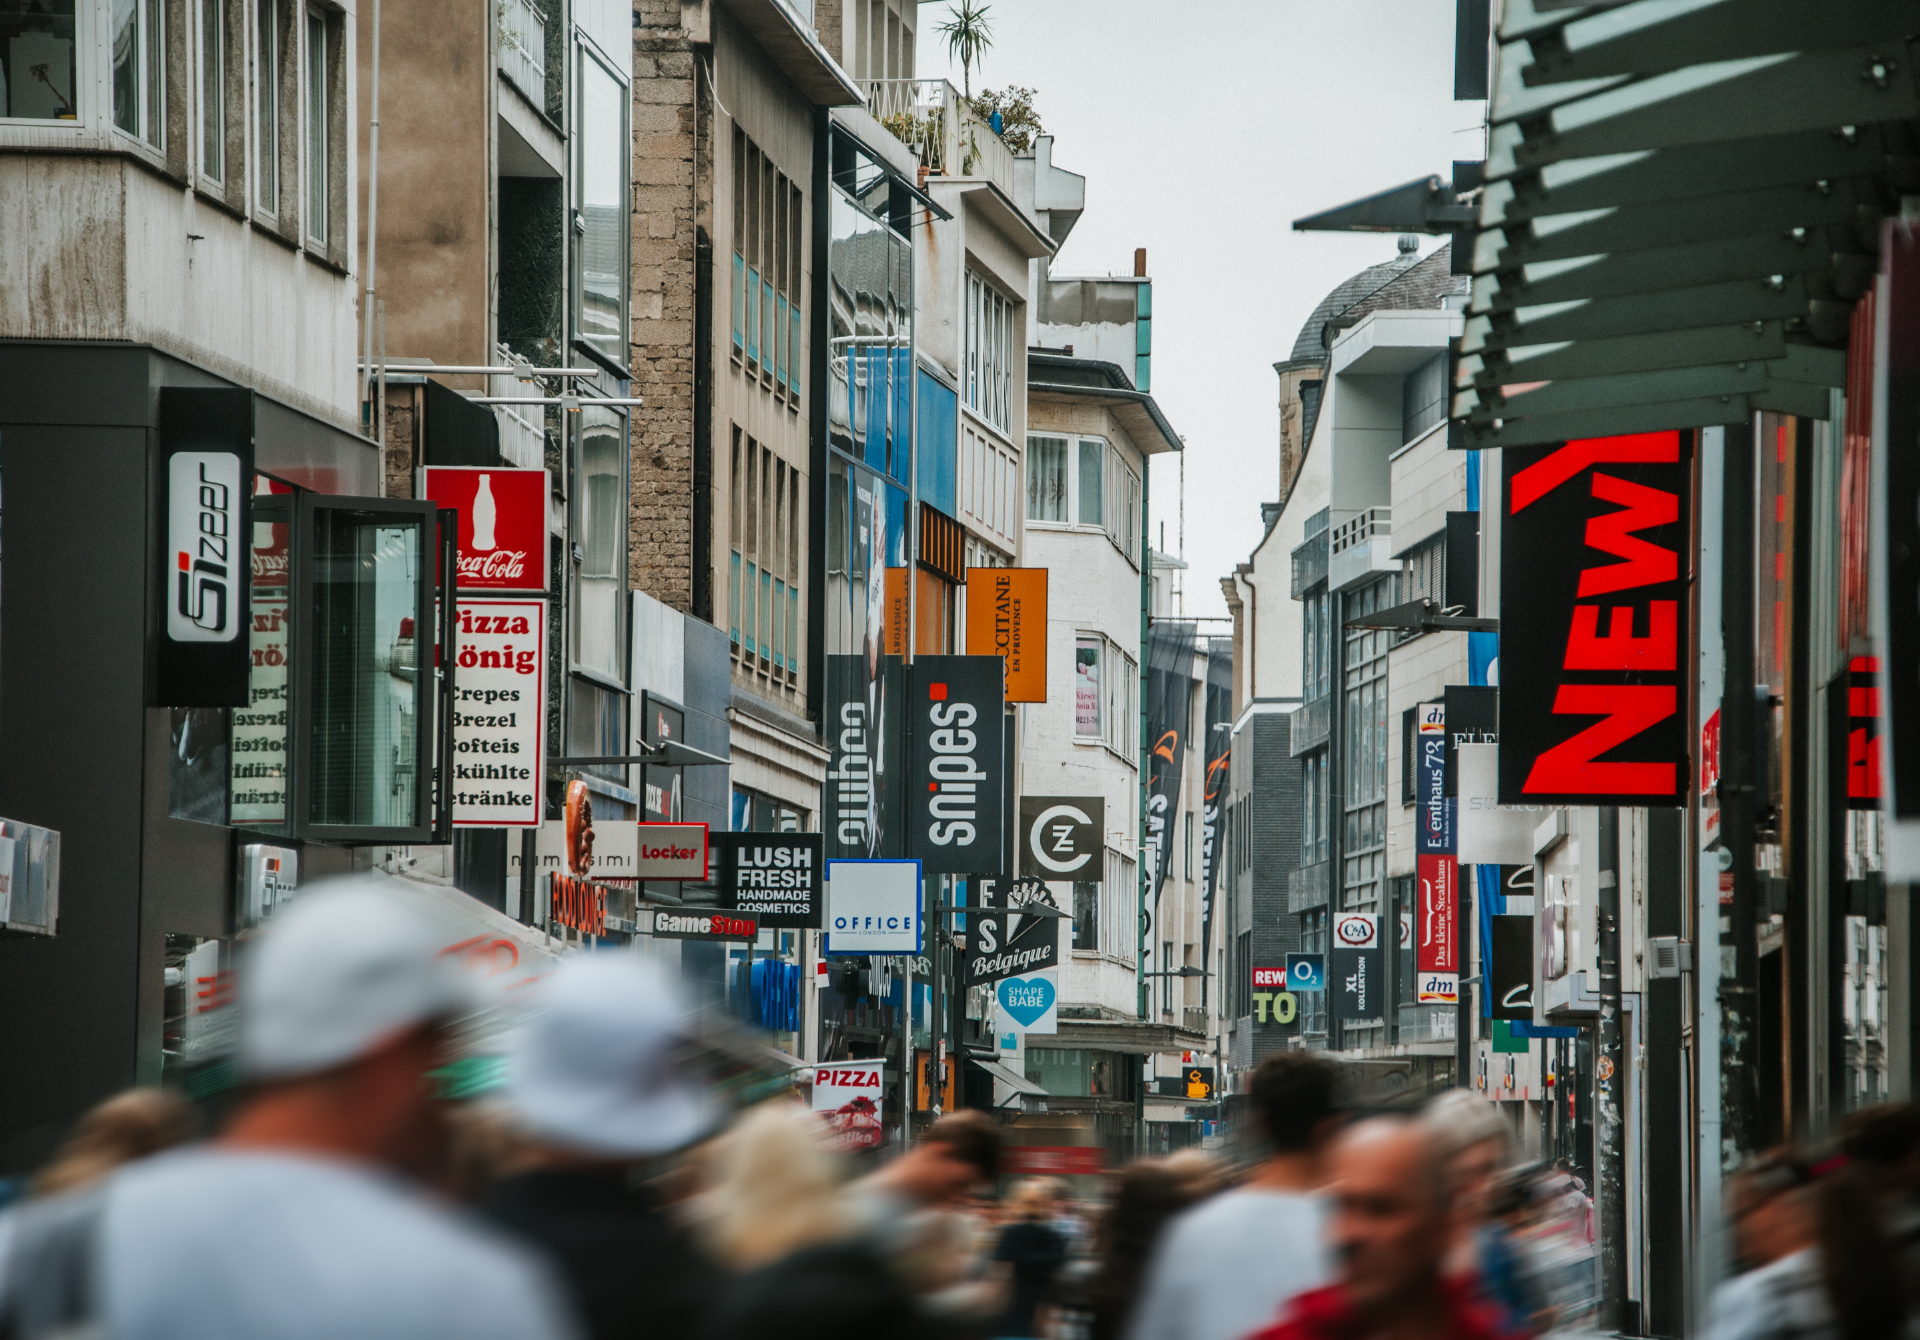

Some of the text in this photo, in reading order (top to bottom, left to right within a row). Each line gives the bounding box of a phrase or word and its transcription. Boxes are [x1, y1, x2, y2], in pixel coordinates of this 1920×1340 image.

[457, 550, 527, 578] oca-Cola
[1013, 598, 1021, 672] EN PROVENCE
[1522, 472, 1678, 795] NEW
[929, 702, 986, 846] snipes
[642, 844, 697, 860] Locker
[737, 847, 812, 868] LUSH
[737, 869, 812, 888] FRESH
[737, 889, 811, 901] HANDMADE
[736, 902, 811, 914] COSMETICS
[1435, 859, 1446, 967] Das kleine Steakhaus
[655, 912, 756, 937] GameStop
[835, 917, 911, 929] OFFICE
[1344, 923, 1368, 937] C&A
[972, 945, 1051, 977] Belgique
[1255, 970, 1287, 985] REW
[1345, 973, 1358, 993] XL
[1358, 956, 1366, 1011] KOLLEKTION
[1426, 976, 1453, 993] dm
[1008, 987, 1044, 996] SHAPE
[1008, 996, 1044, 1007] BABE
[1253, 992, 1297, 1024] TO
[815, 1069, 880, 1088] PIZZA
